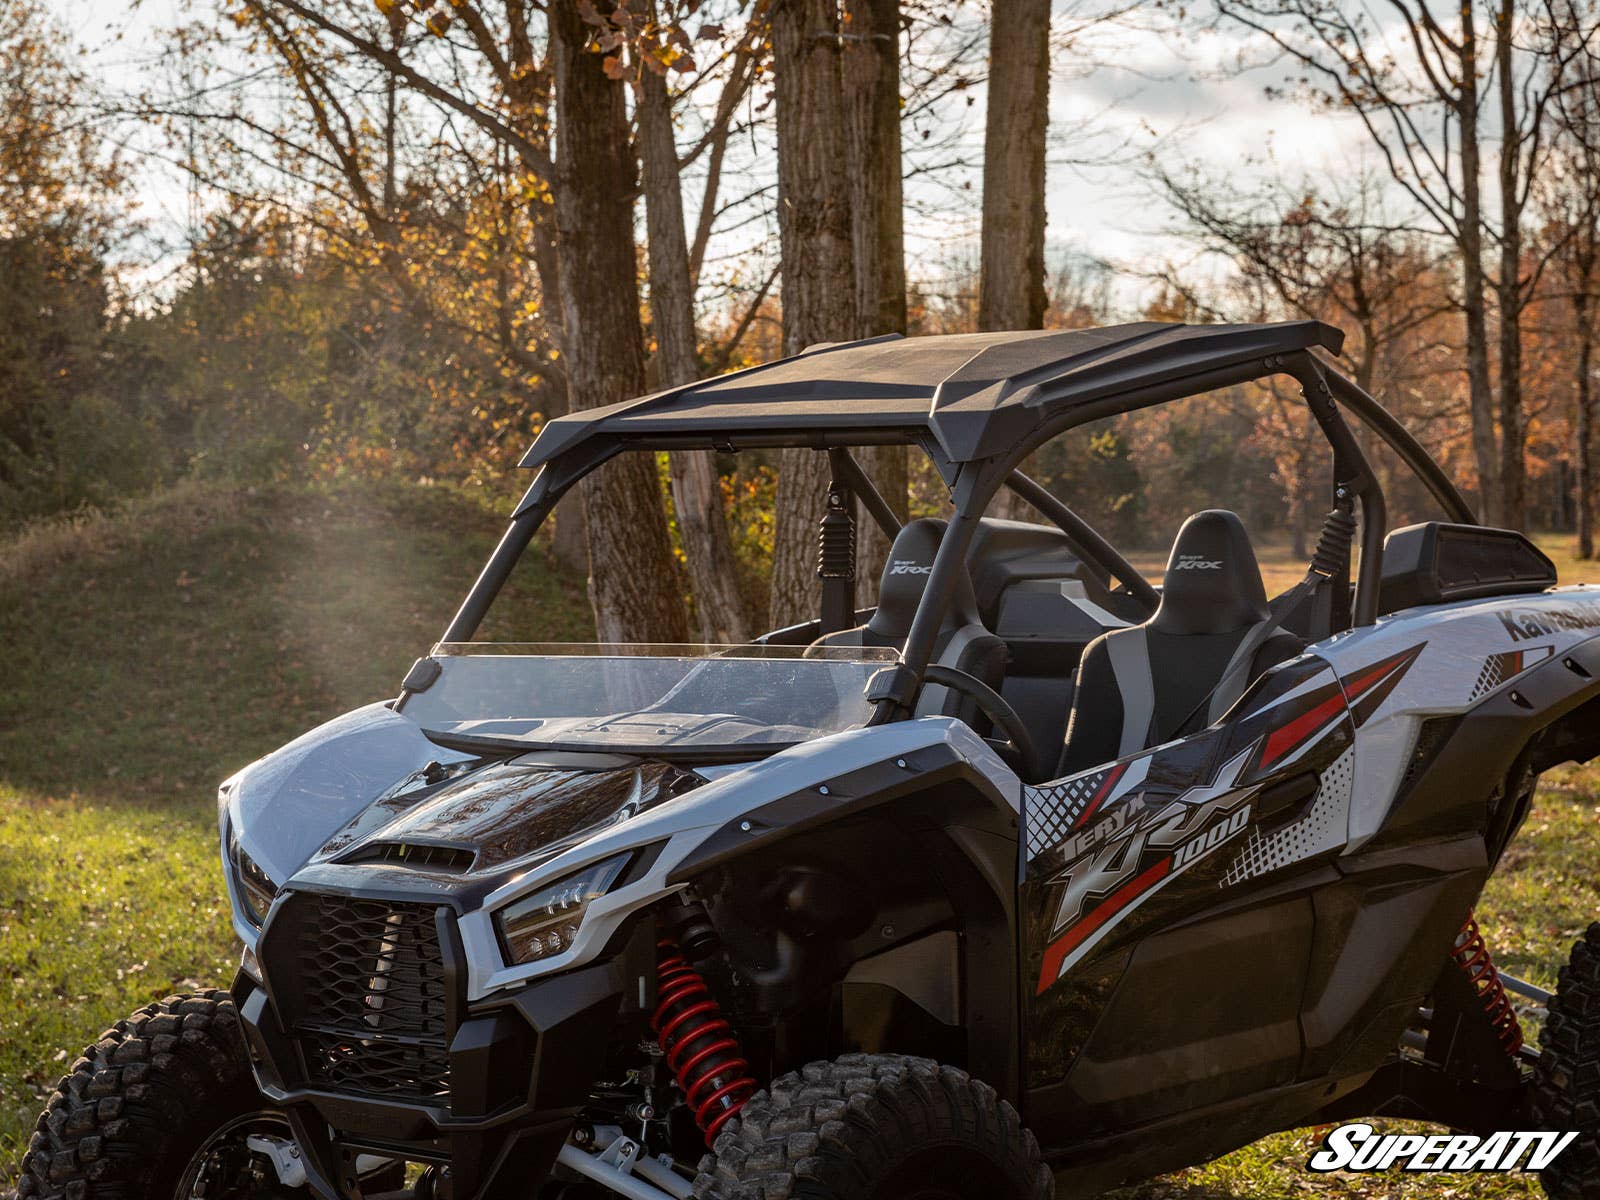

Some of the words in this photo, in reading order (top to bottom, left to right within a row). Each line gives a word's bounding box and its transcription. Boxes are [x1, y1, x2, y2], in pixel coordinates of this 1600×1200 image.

[890, 566, 933, 575] KRX
[1175, 560, 1224, 570] KRX
[1045, 735, 1265, 943] KRX
[1056, 791, 1146, 861] TERYX
[1173, 805, 1251, 871] 1000
